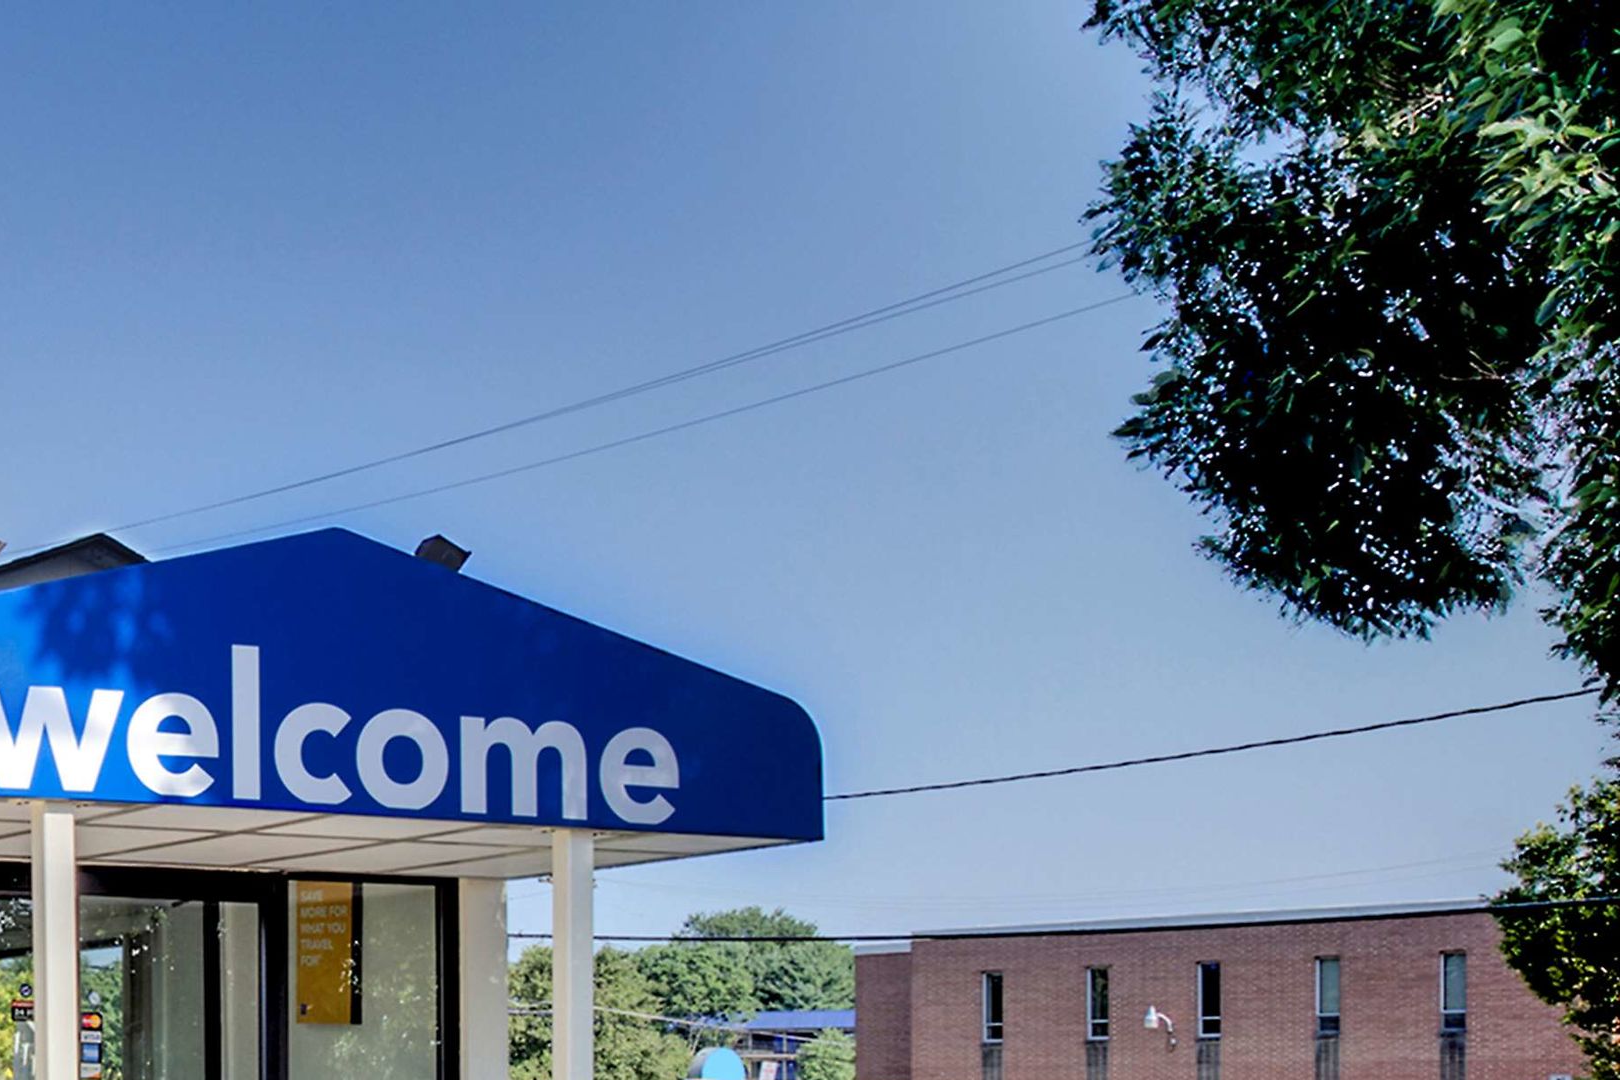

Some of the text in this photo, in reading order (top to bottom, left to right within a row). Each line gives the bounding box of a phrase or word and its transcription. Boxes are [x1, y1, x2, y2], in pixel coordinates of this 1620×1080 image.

[300, 889, 324, 902] SAVE
[300, 905, 348, 918] MORE FOR
[300, 922, 346, 934] WHAT YOU
[300, 939, 334, 951] TRAVEL
